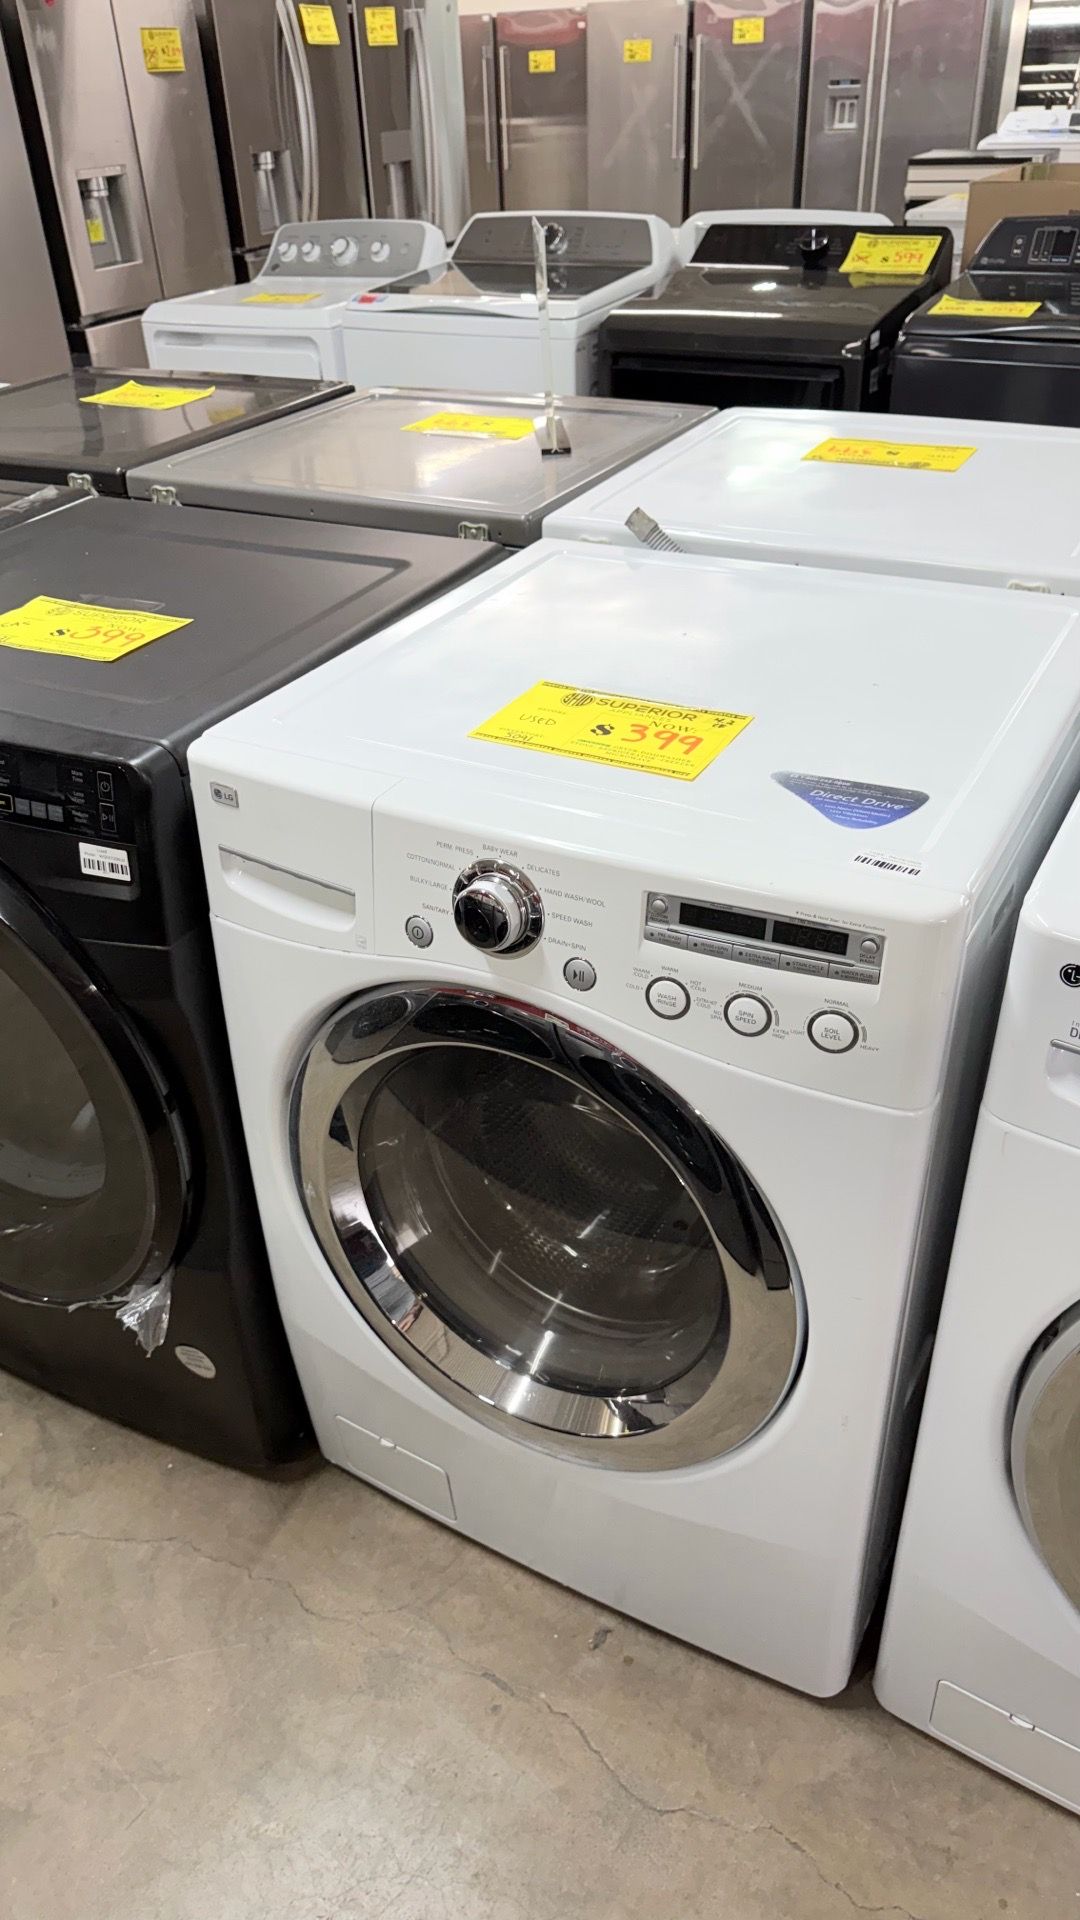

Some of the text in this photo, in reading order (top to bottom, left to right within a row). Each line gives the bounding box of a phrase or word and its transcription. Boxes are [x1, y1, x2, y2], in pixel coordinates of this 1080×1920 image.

[73, 610, 146, 624] SUPERIOR
[50, 626, 146, 646] $ 399
[595, 698, 699, 722] SUPERIOR
[590, 724, 615, 736] $
[620, 724, 704, 756] 399
[810, 790, 858, 803] Direct
[861, 798, 904, 810] Drive
[455, 844, 474, 856] PRESS
[482, 844, 518, 857] BABY WEAR
[526, 864, 560, 877] DELICATES
[544, 888, 606, 908] HAND WASH/WOOL
[422, 903, 450, 915] SANITARY
[551, 912, 593, 927] SPEED WASH
[738, 982, 763, 991] MEDIUM
[655, 999, 677, 1007] /RINSE
[657, 993, 677, 1001] WASH
[824, 998, 849, 1007] NORMAL
[735, 1016, 757, 1024] SPEED
[738, 1010, 754, 1018] SPIN
[821, 1033, 842, 1041] LEVEL
[824, 1027, 840, 1035] SOIL
